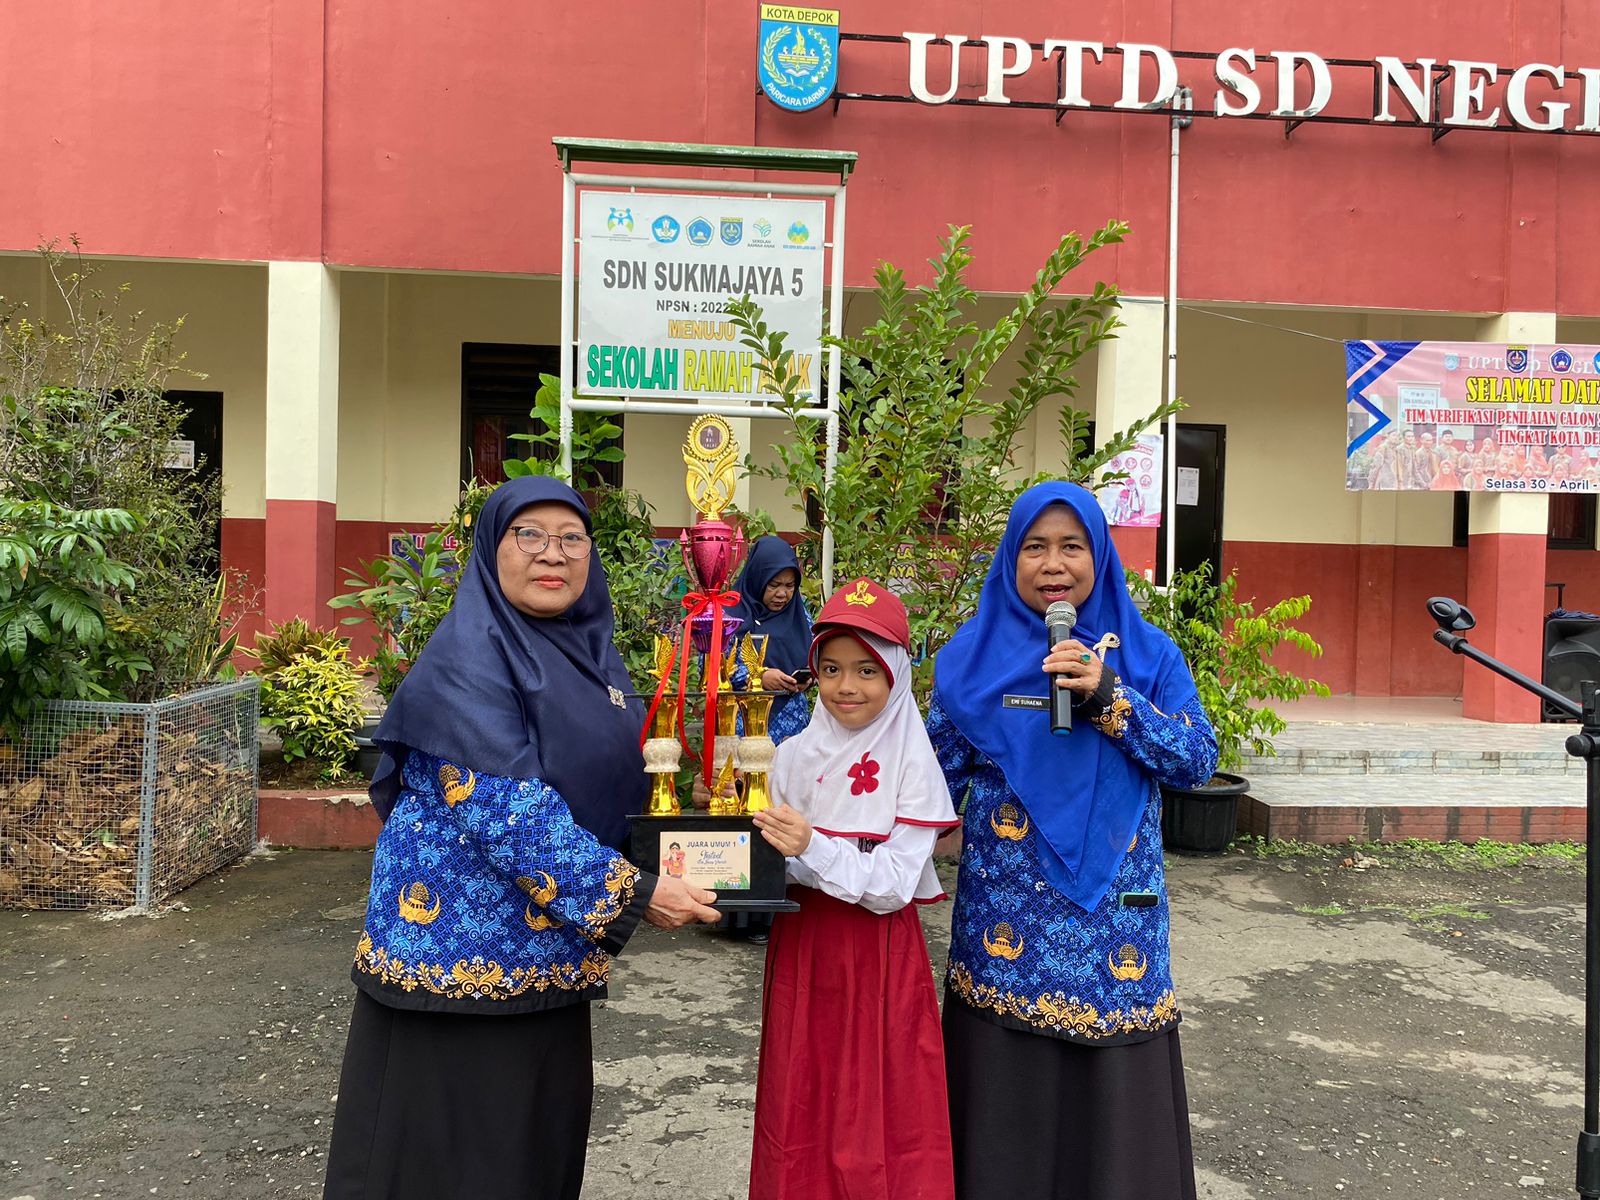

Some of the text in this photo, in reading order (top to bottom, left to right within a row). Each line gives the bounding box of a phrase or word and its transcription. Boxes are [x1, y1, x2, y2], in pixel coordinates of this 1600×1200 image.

[766, 8, 834, 23] KOTA DEPOK
[902, 31, 1179, 110] UPTD
[1215, 47, 1333, 117] SD
[766, 82, 828, 106] PARICARA DARMA
[603, 259, 804, 297] SDN SUKMAJAYA 5
[656, 300, 690, 313] NPSN
[668, 319, 736, 342] MENUJU
[586, 344, 679, 390] SEKOLAH
[684, 348, 752, 393] RAMAH
[1466, 376, 1600, 405] SELAMAT DAT
[1405, 408, 1426, 423] TIM
[1430, 409, 1493, 424] VERIFIKASI
[1497, 410, 1556, 426] PENILAIAN
[1560, 412, 1595, 426] CALON
[1497, 429, 1546, 445] TINGKAT
[1550, 431, 1580, 446] KOTA
[1486, 478, 1526, 489] Selasa
[1530, 479, 1547, 489] 30
[1560, 480, 1589, 491] April
